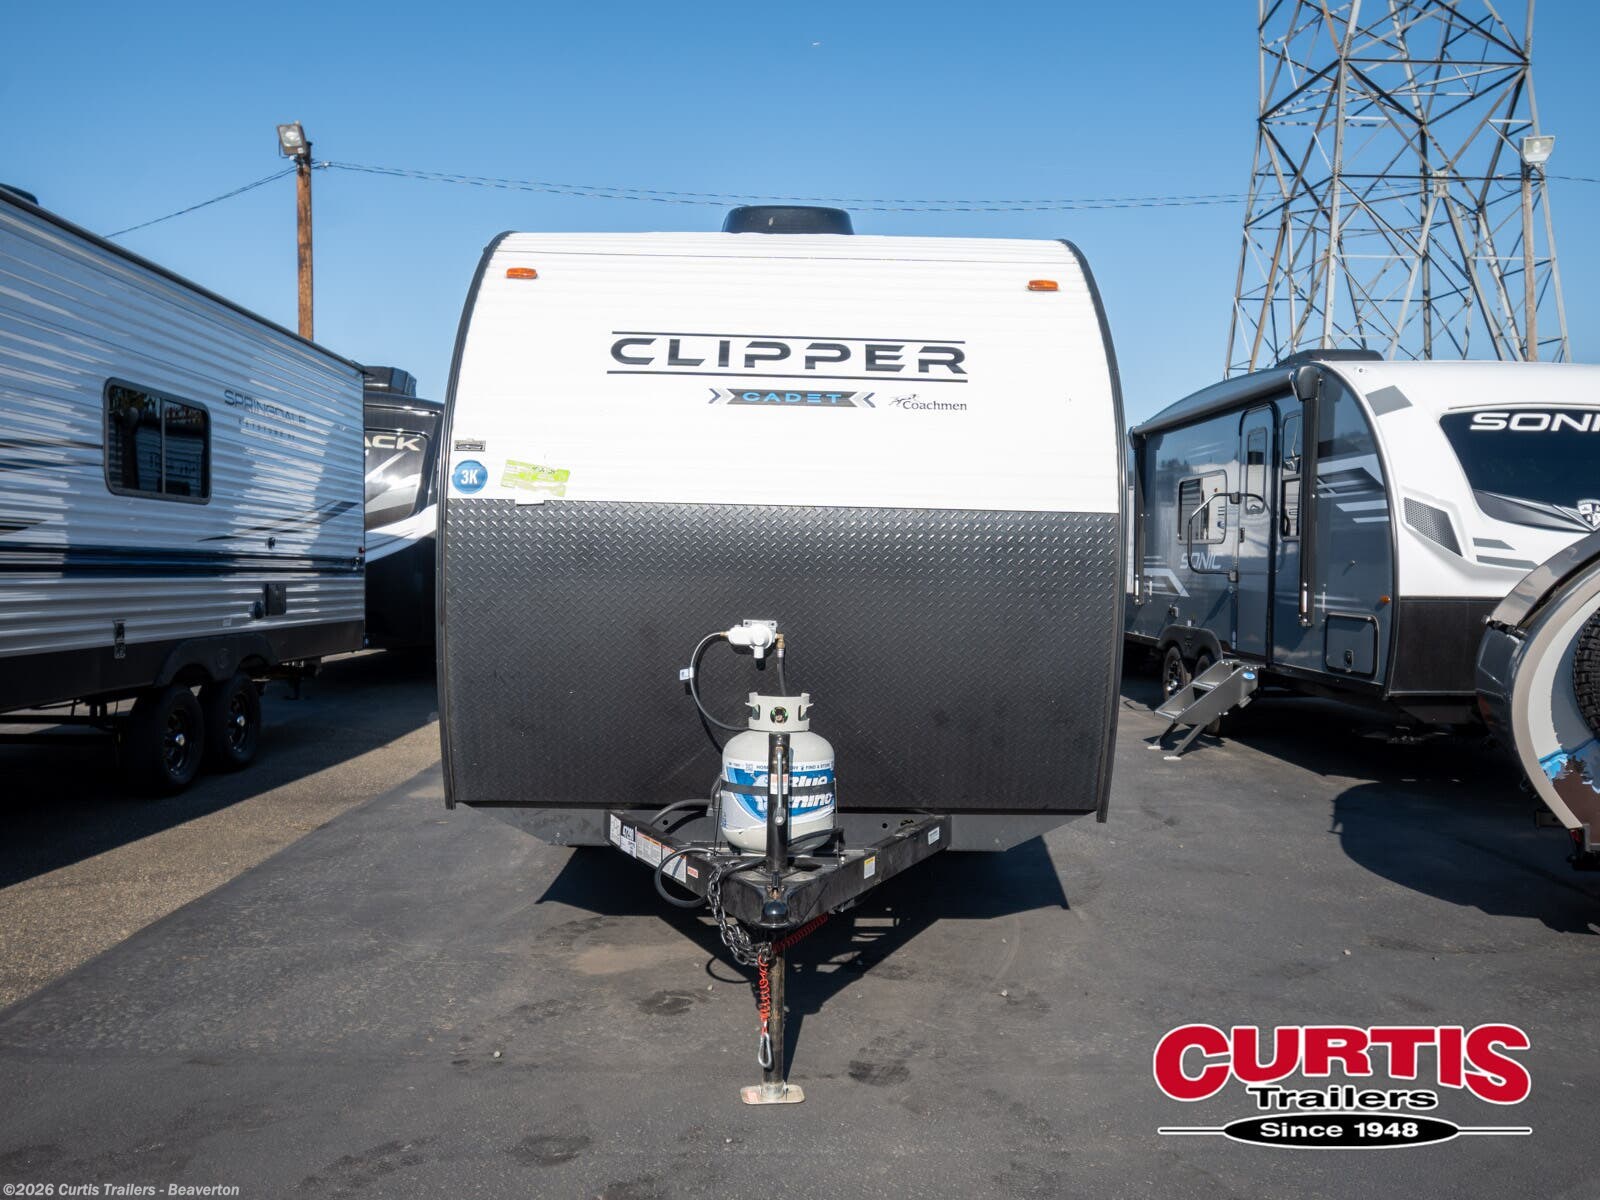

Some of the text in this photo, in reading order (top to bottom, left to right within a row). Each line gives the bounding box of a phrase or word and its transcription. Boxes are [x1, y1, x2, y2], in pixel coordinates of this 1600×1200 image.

[610, 338, 968, 375] CLIPPER
[742, 391, 842, 404] CADET
[902, 398, 967, 411] Coachmen
[224, 389, 306, 424] SPRINGDALE
[460, 468, 479, 485] 3K
[1179, 552, 1222, 569] SONIC
